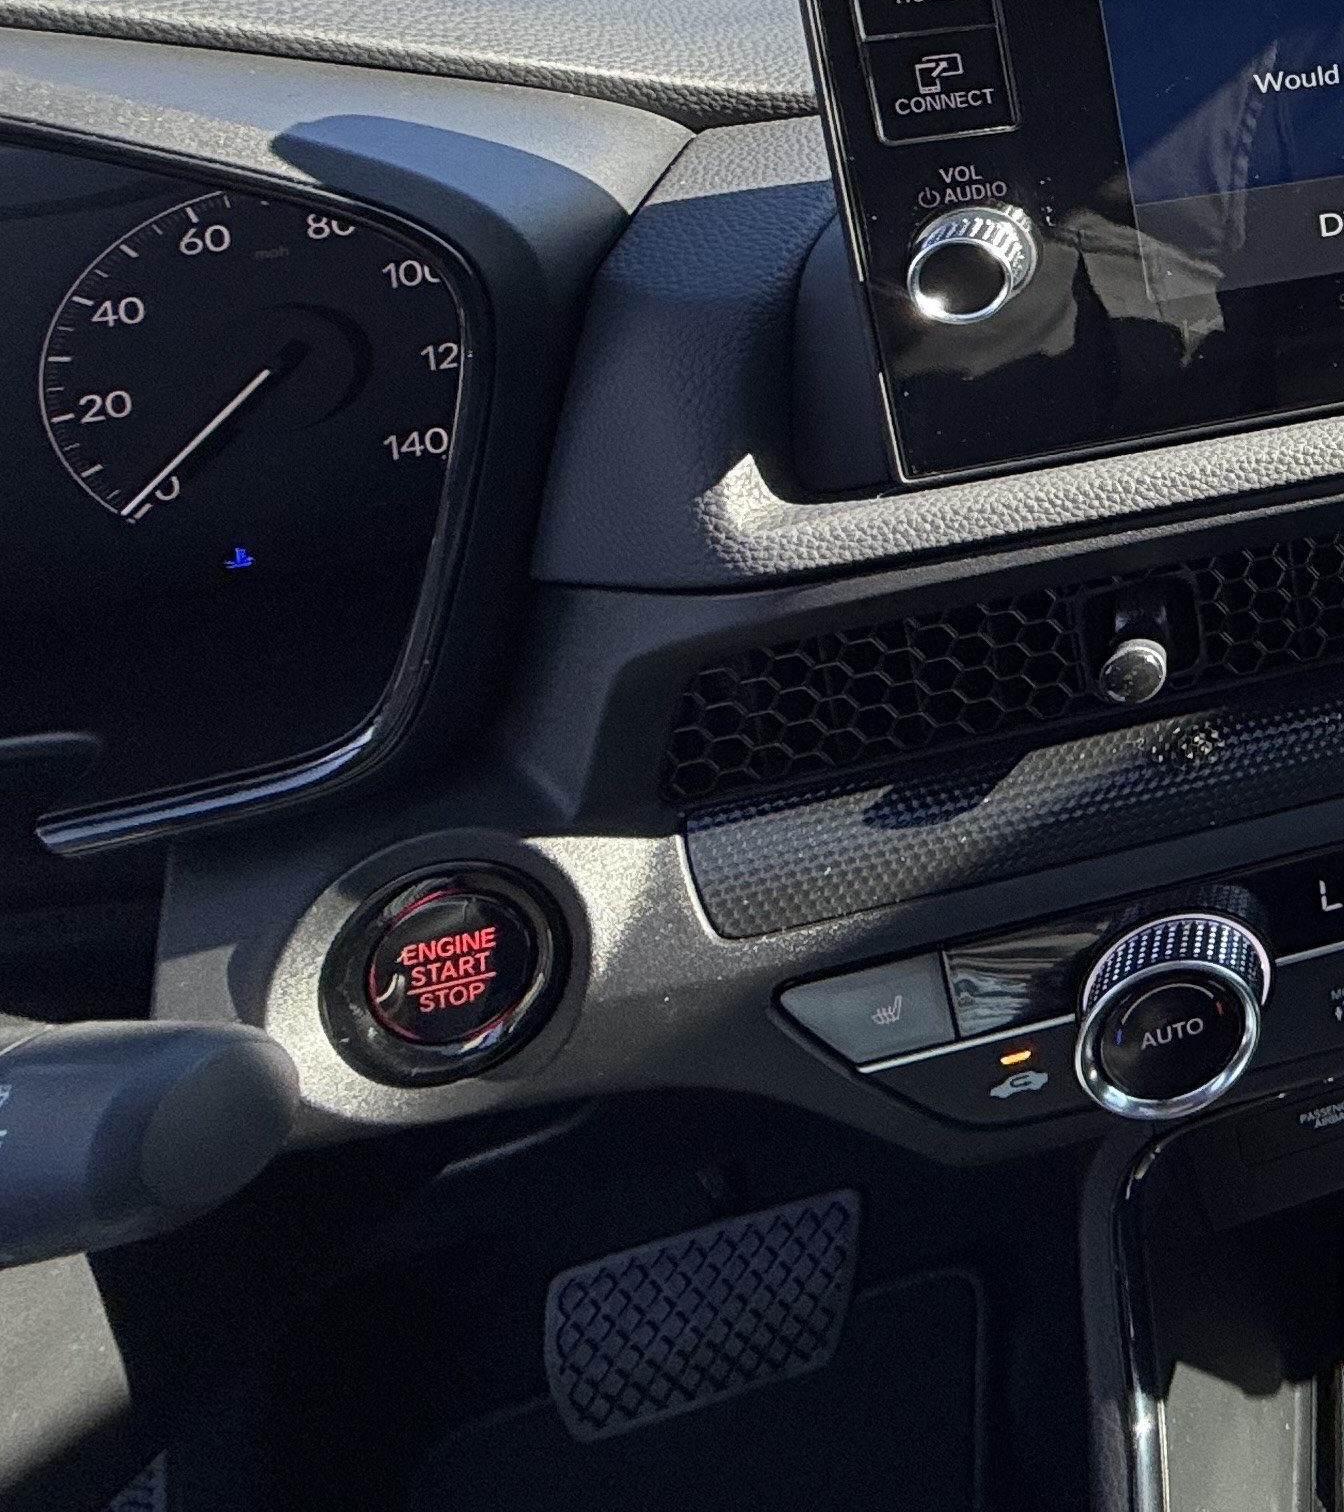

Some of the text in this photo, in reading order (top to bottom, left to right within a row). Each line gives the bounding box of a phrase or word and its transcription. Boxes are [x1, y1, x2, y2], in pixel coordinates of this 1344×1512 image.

[1253, 65, 1340, 94] Would
[894, 88, 994, 116] CONNECT
[939, 164, 983, 184] VOL
[944, 180, 1007, 205] AUDIO
[179, 223, 231, 255] 60
[92, 297, 146, 329] 40
[79, 390, 133, 424] 20
[383, 427, 449, 461] 140
[402, 927, 497, 966] ENGINE
[411, 951, 490, 986] START
[420, 982, 486, 1012] STOP
[1141, 1017, 1204, 1050] AUTO
